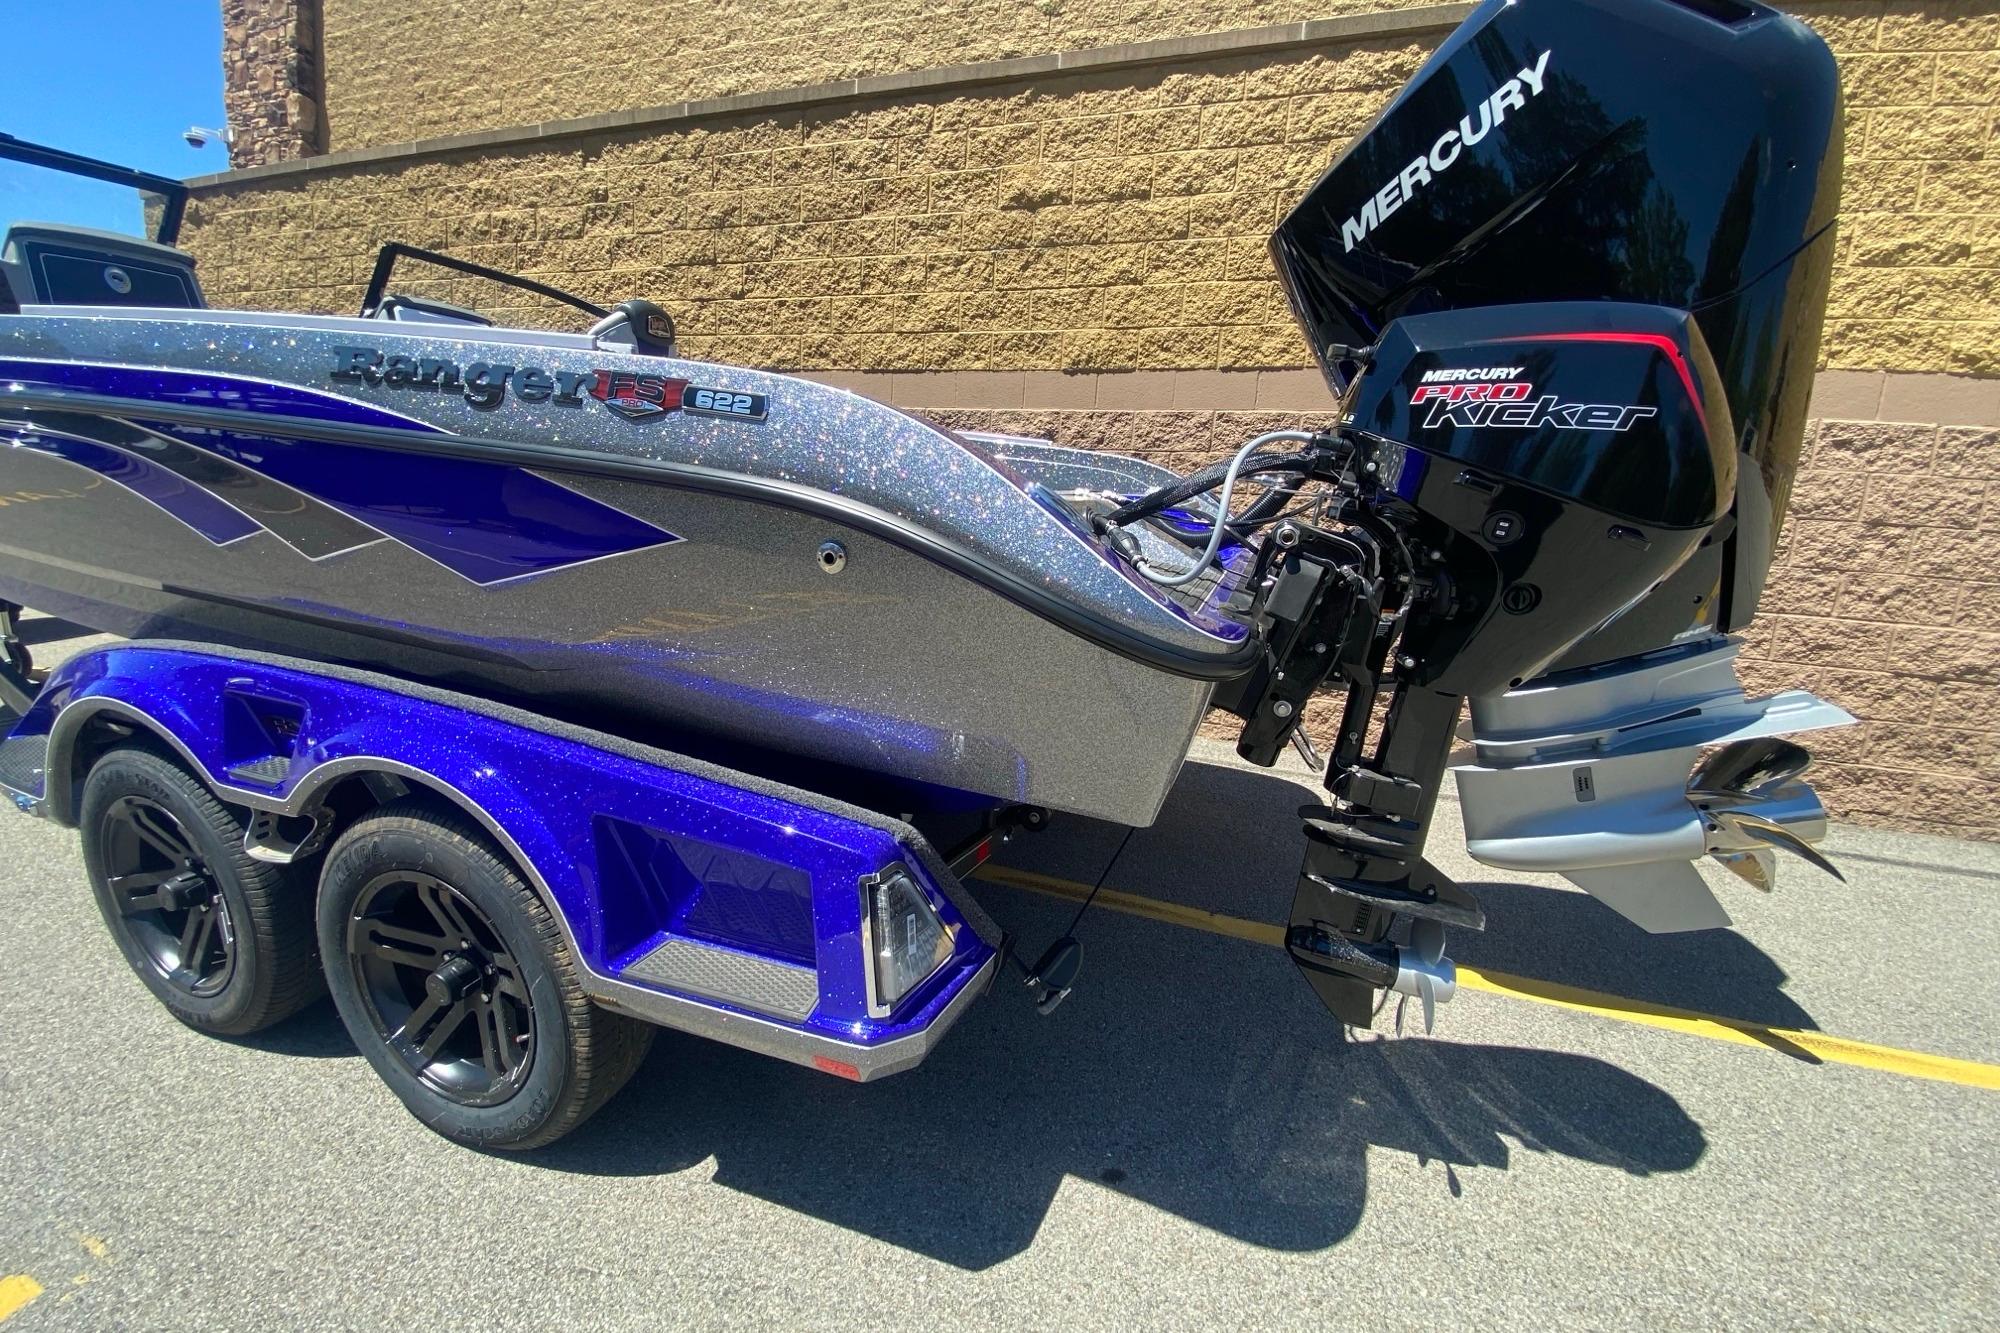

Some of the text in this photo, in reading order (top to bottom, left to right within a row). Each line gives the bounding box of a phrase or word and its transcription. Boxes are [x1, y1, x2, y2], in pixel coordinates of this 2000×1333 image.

[1342, 49, 1551, 253] MERCURY
[330, 344, 753, 415] Ranger FS 622
[1421, 367, 1526, 383] MERCURY
[621, 398, 644, 407] PRO
[1410, 383, 1532, 404] PRO
[1423, 396, 1658, 431] Kicker
